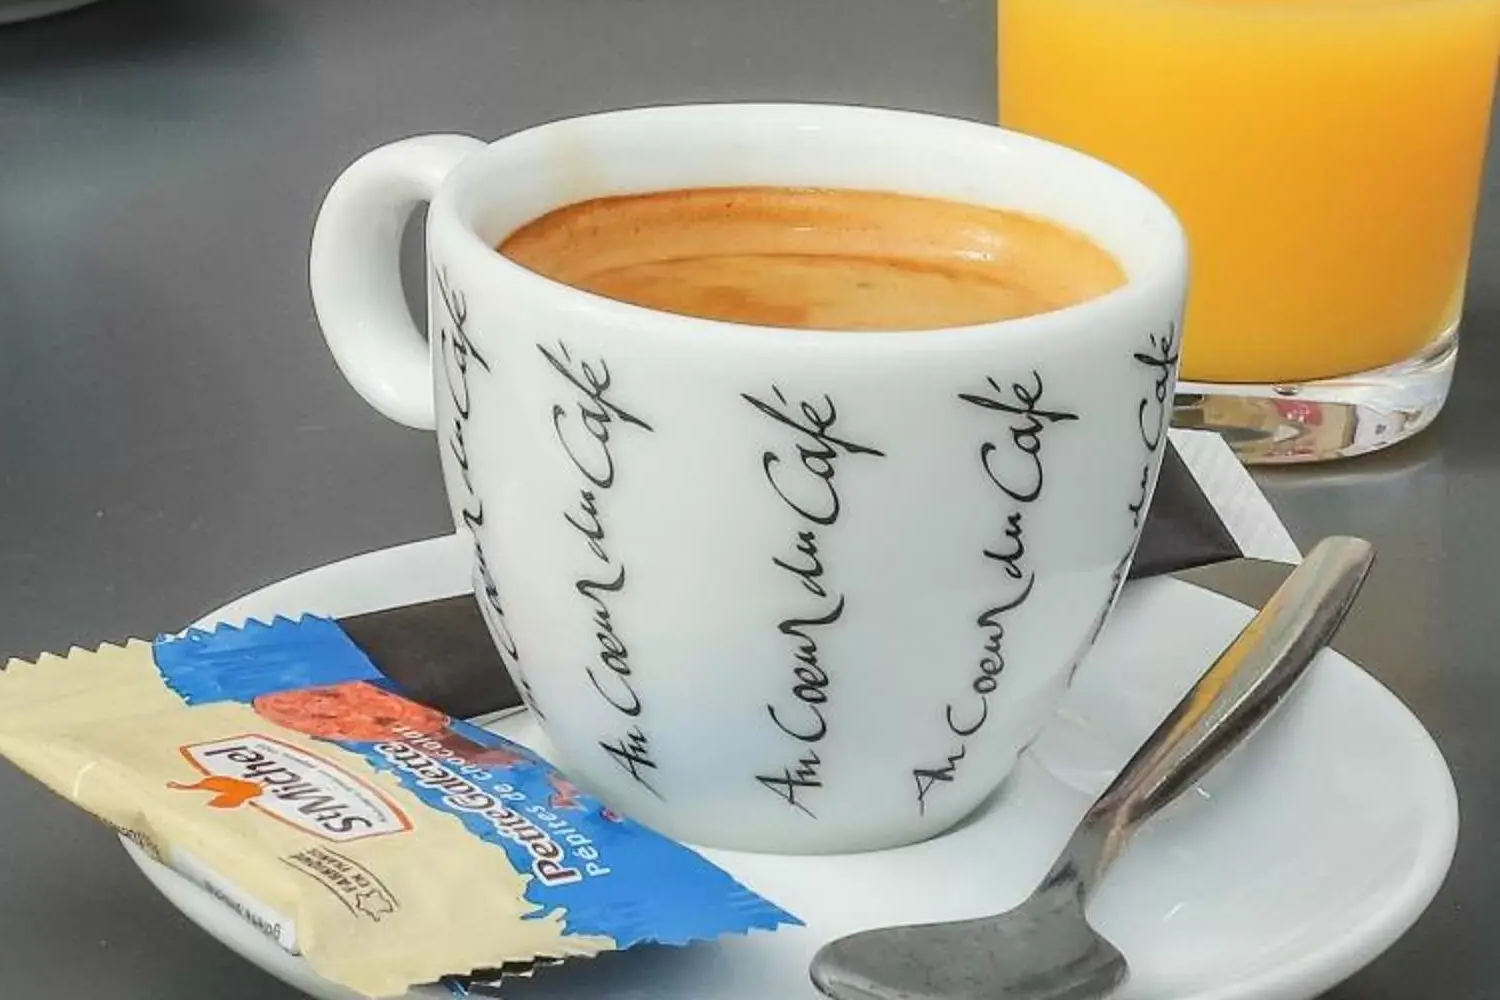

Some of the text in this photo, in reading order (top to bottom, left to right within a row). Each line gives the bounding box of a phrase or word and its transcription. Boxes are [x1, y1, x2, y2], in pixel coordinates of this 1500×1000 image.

[536, 339, 655, 489] Café
[957, 370, 1080, 503] Café
[740, 384, 887, 526] Café
[563, 489, 611, 565] du
[772, 531, 827, 598] du
[982, 511, 1025, 580] du
[391, 724, 611, 877] Pépites de chocolat
[598, 725, 666, 802] Au
[754, 747, 821, 819] Au
[912, 744, 966, 816] Au
